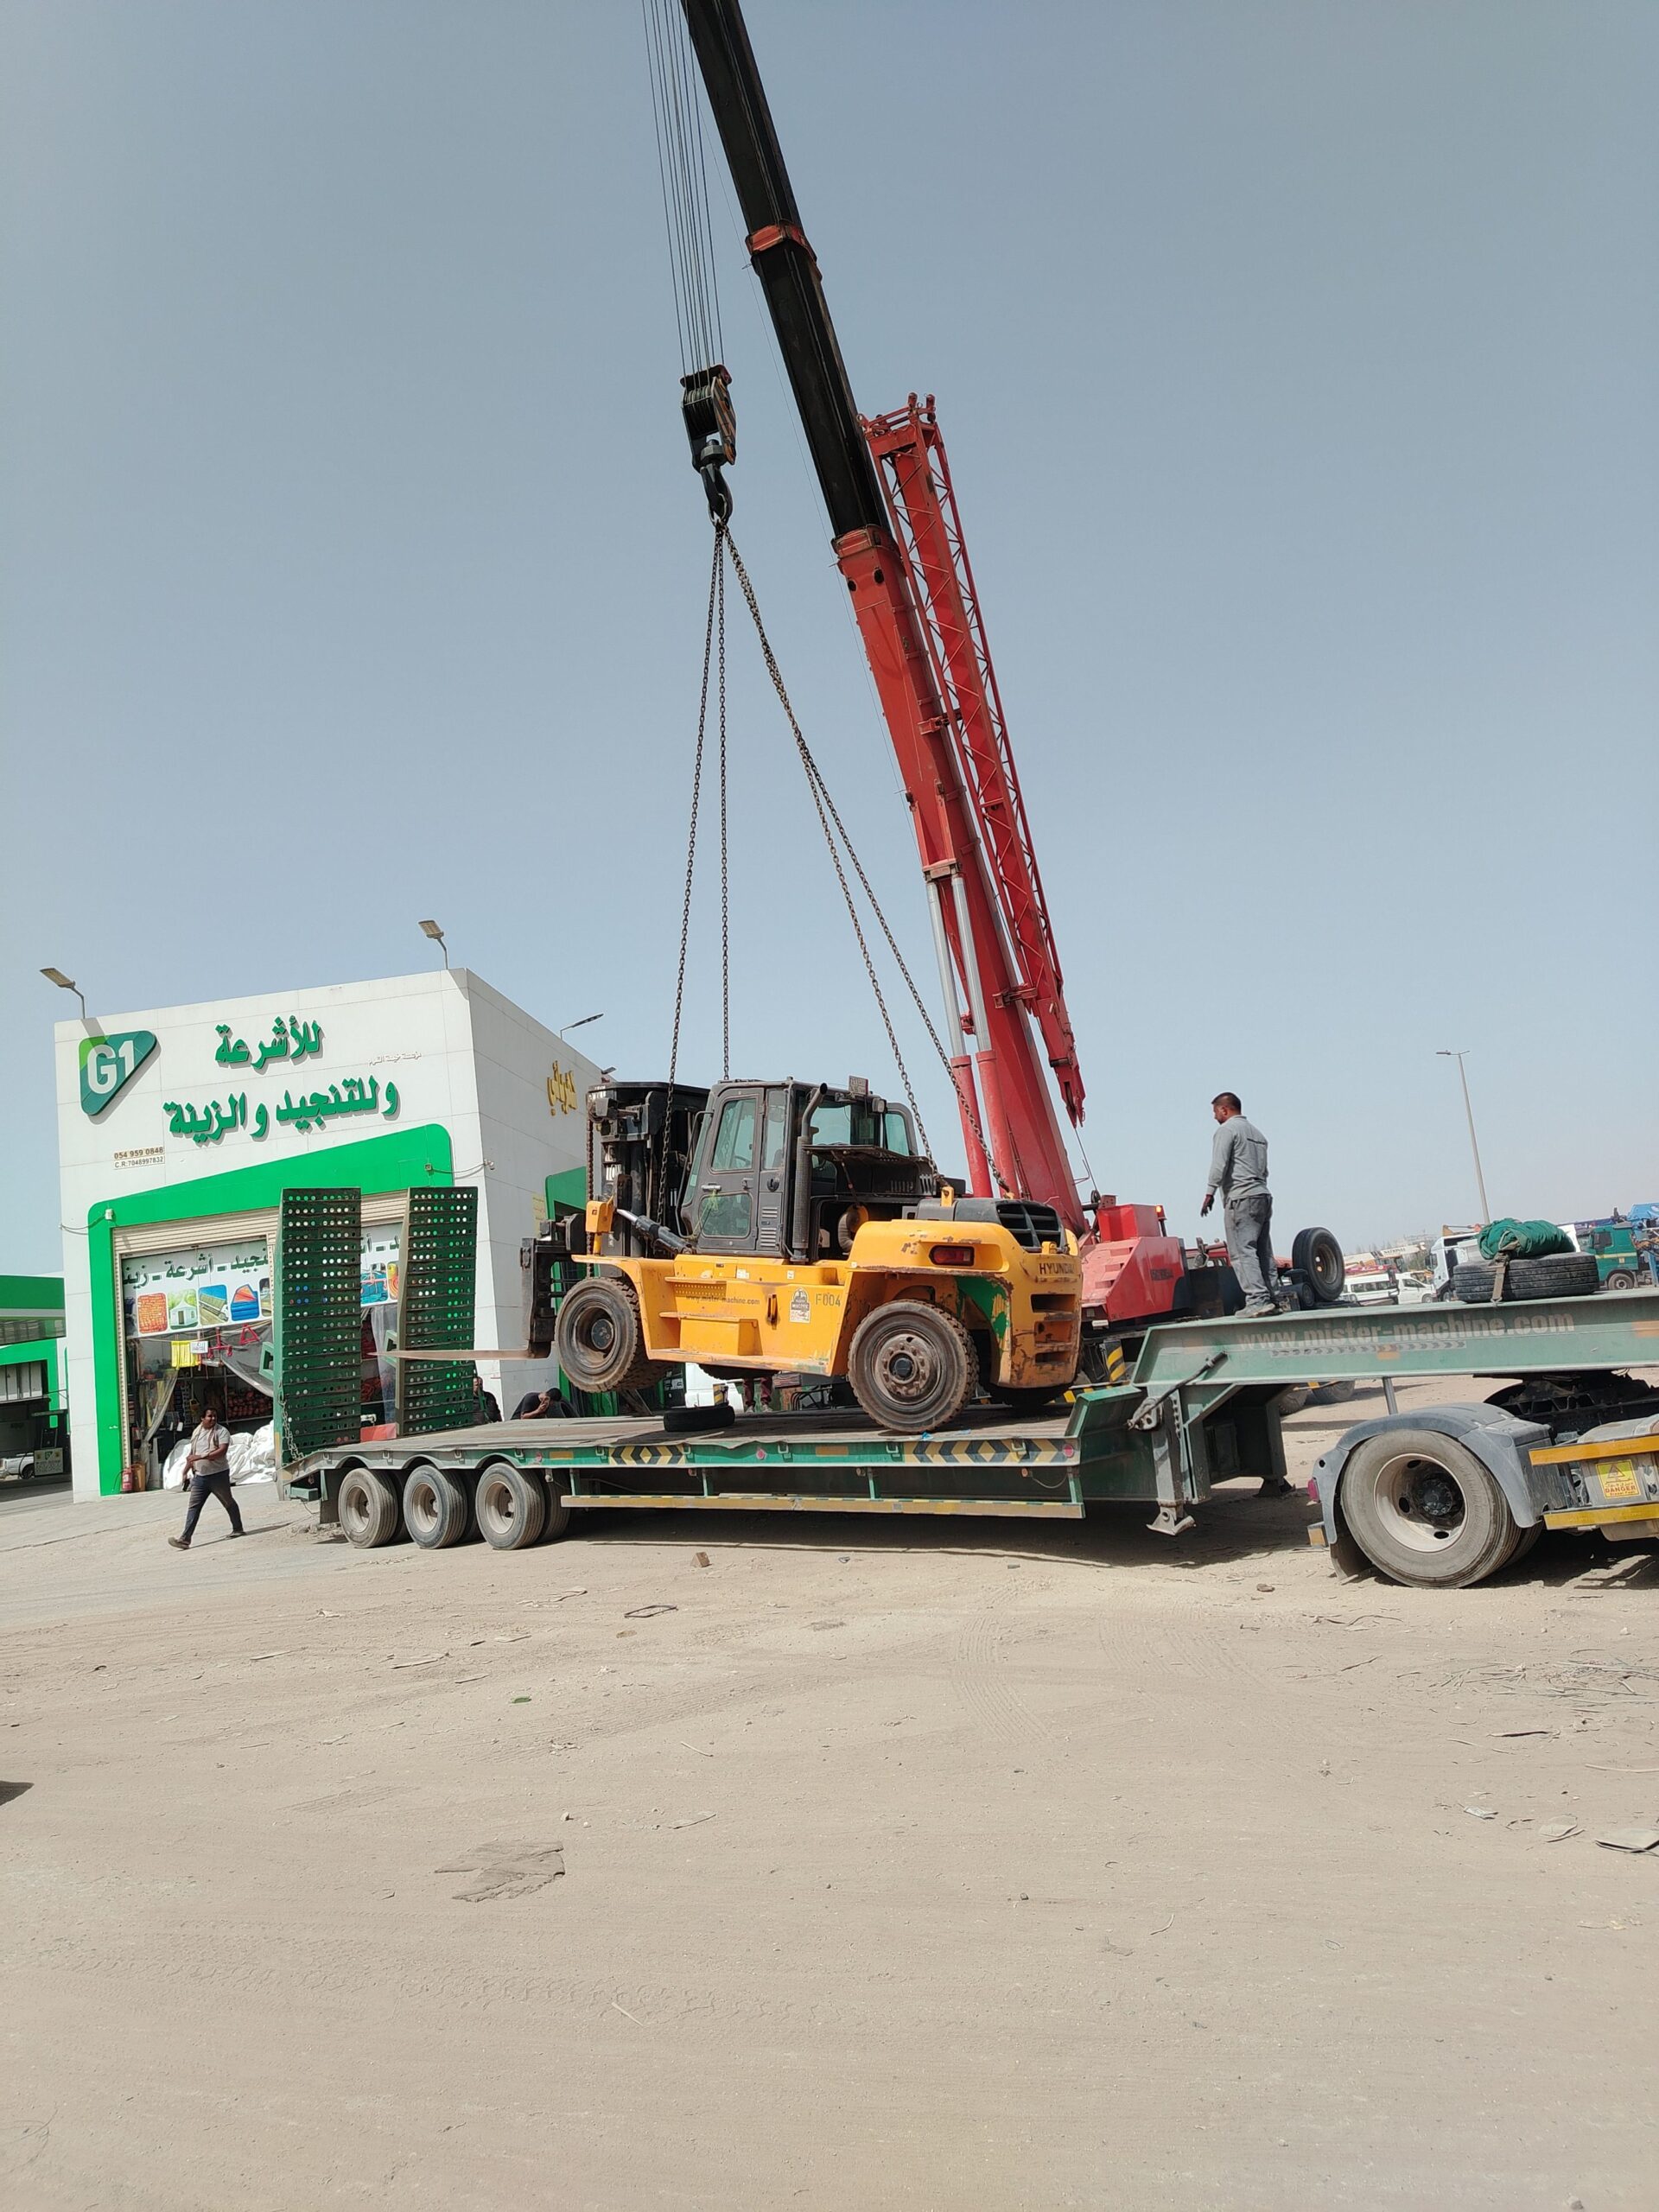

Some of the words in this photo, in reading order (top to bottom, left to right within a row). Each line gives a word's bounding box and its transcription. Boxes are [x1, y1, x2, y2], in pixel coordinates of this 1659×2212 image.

[214, 1014, 323, 1070] للأشرعة
[87, 1039, 135, 1094] G1
[145, 1147, 163, 1155] 0848
[164, 1252, 214, 1281] أشرعة
[231, 1247, 269, 1274] نجيد
[1039, 1262, 1075, 1275] HYUNDAI
[123, 1265, 149, 1289] زين
[815, 1293, 841, 1306] F004
[1236, 1313, 1575, 1351] www.mister-machine.com
